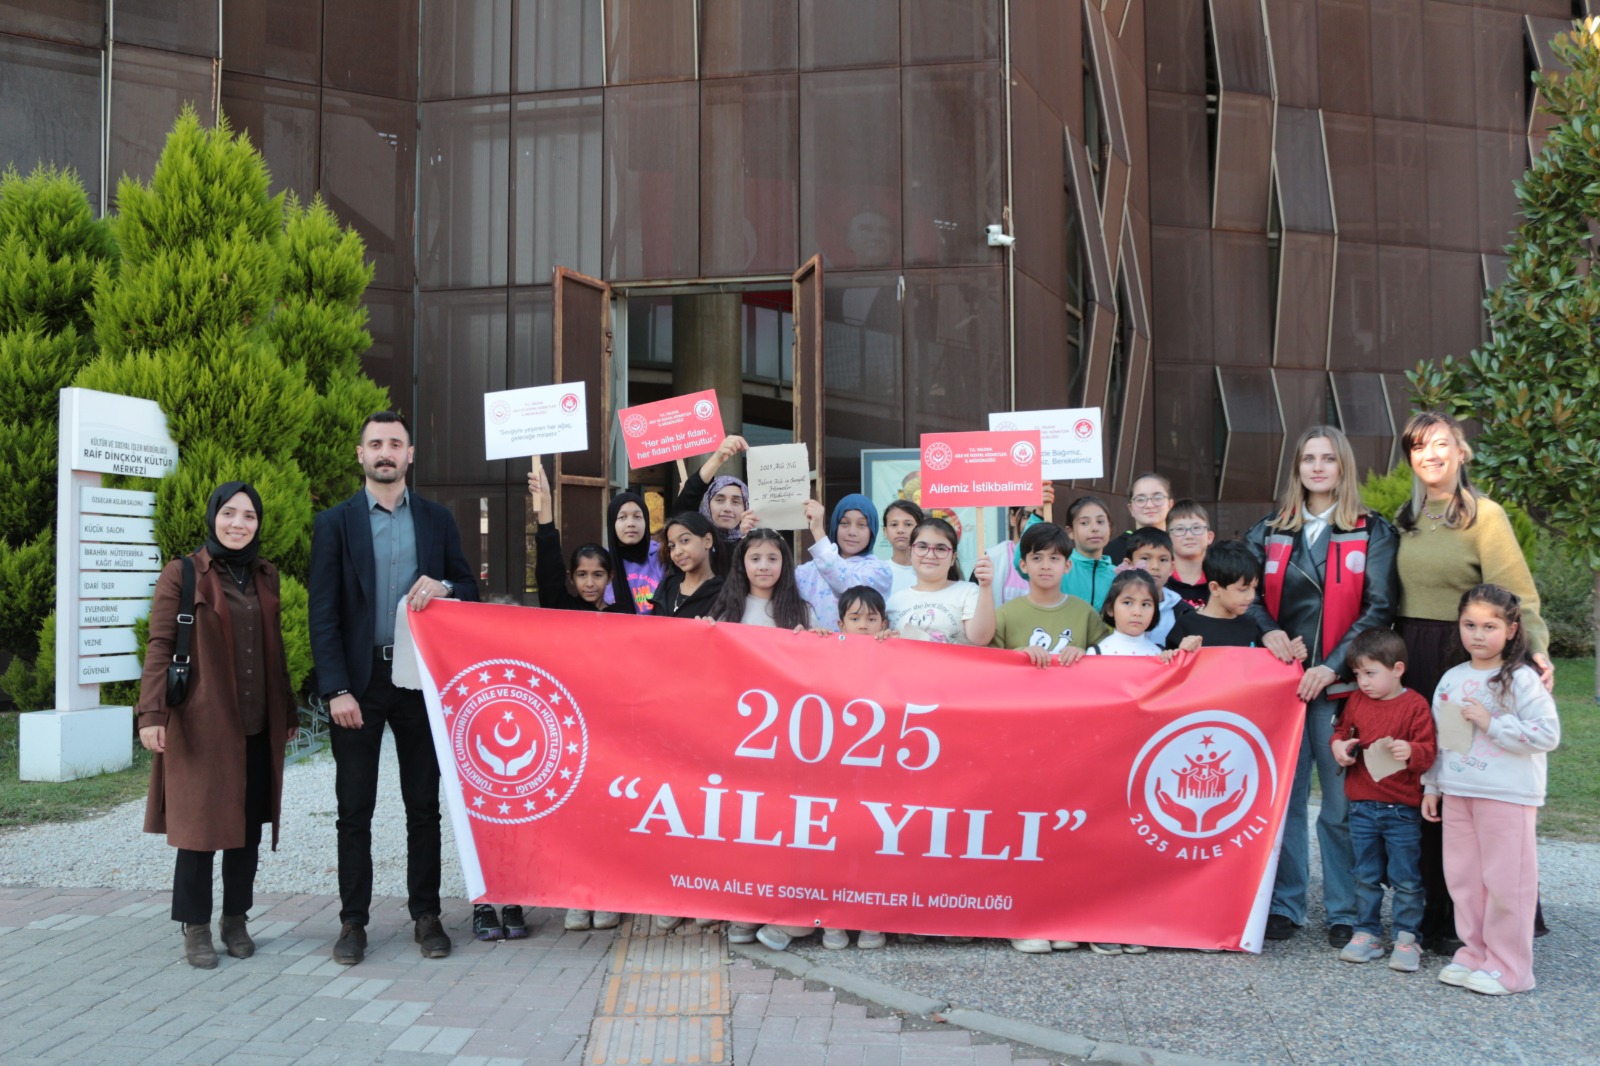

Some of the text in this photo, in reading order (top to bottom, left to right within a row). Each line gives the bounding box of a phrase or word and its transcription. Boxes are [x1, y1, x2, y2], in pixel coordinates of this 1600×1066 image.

[661, 436, 675, 445] aile
[676, 433, 685, 441] bir
[84, 448, 173, 467] RAİF DİNÇKÖK KÜLTÜR
[637, 450, 650, 459] her
[652, 447, 671, 456] fidan
[113, 464, 147, 475] MERKEZİ
[929, 480, 1033, 494] Ailemiz İstikbalimiz
[84, 523, 125, 534] KÜÇÜK SALON
[84, 547, 143, 557] İBRAHİM MÜTEFERRİKA
[95, 558, 134, 567] KAĞIT MÜZESİ
[84, 581, 115, 591] İDARİ İŞLER
[85, 604, 118, 613] EVLENDİRME
[84, 614, 119, 623] MEMURLUĞU
[84, 639, 102, 647] VEZNE
[83, 665, 111, 675] GÜVENLİK
[734, 688, 941, 771] 2025
[455, 688, 559, 795] TÜRKİYE CUMHURİYETİ AİLE VE SOSYAL HİZMETLER BAKANLIĞI
[608, 773, 1088, 862] “AİLE YILI”
[1129, 813, 1268, 860] 2025 AİLE YILI
[670, 874, 1013, 910] YALOVA AİLE VE SOSYAL HİZMETLER İL MÜDÜRLÜĞÜ
